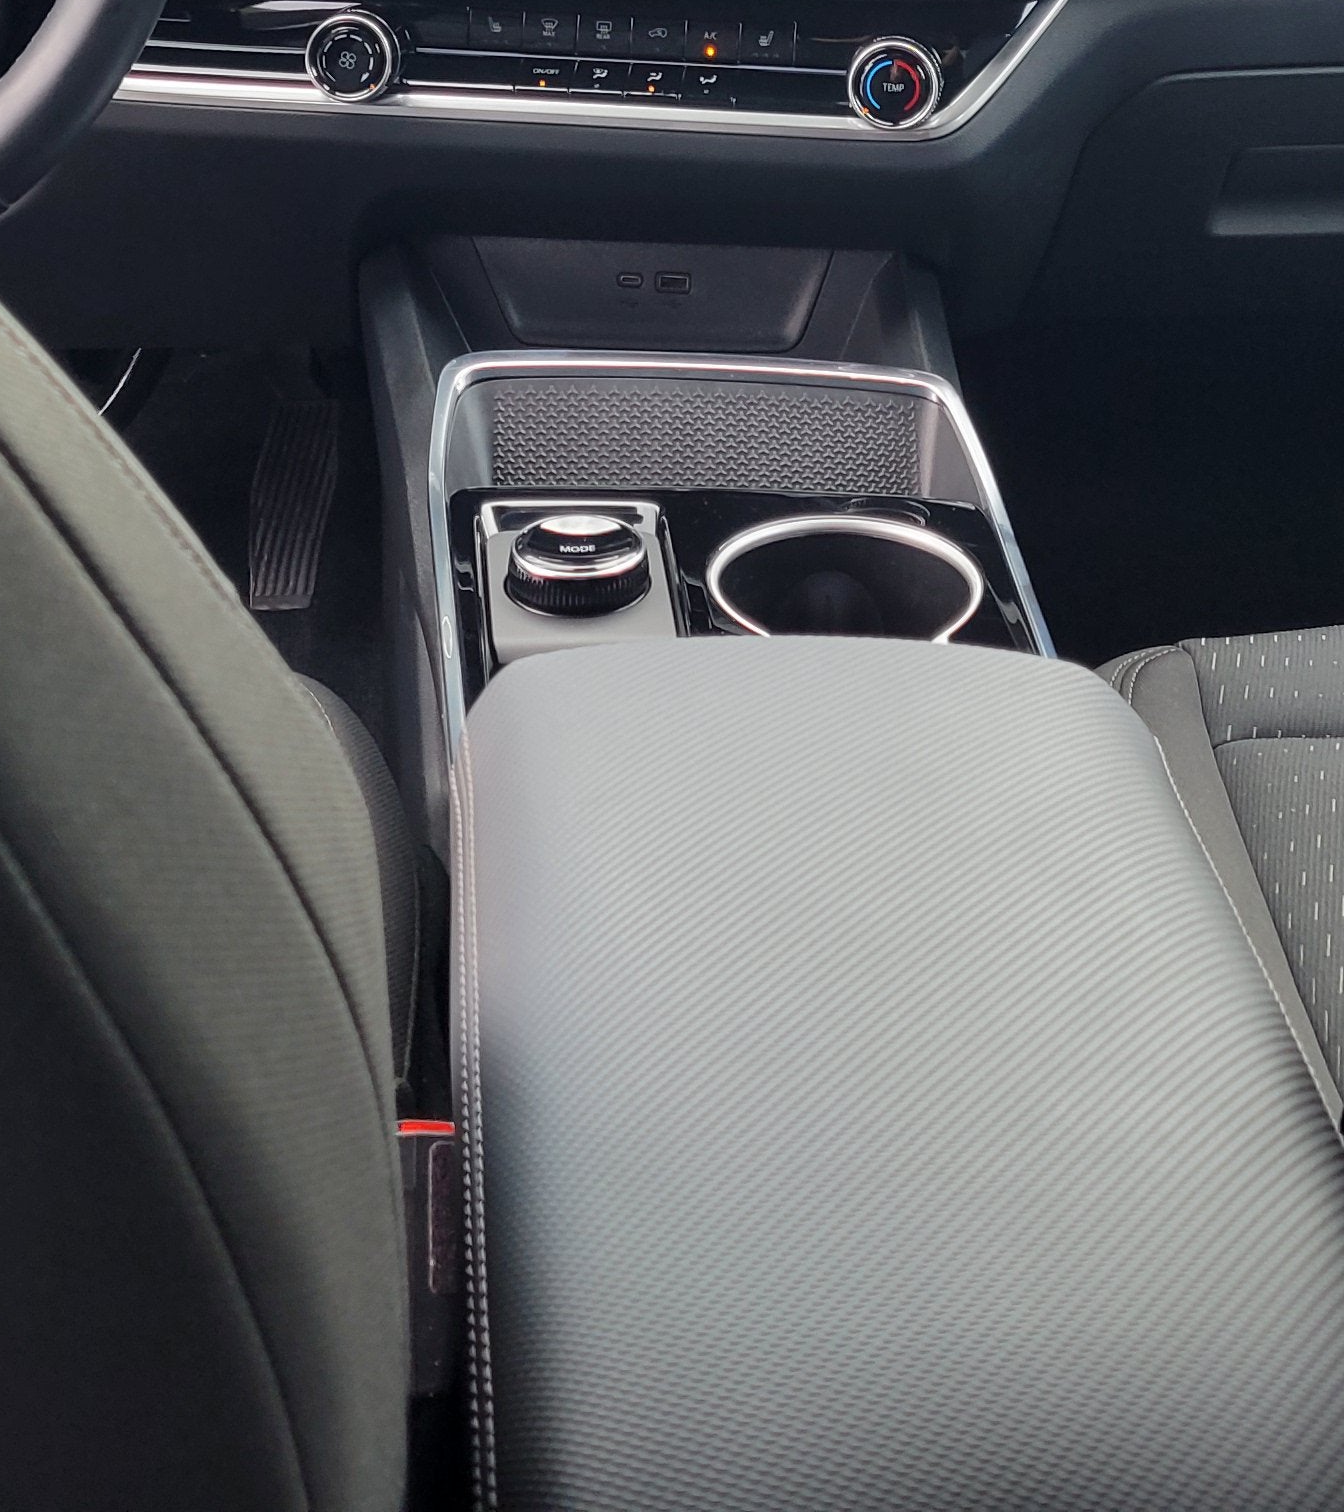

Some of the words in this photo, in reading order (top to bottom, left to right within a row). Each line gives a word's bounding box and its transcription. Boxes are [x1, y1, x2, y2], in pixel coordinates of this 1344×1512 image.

[704, 31, 717, 40] A/C
[882, 82, 905, 92] TEMP
[559, 544, 596, 553] MODE
